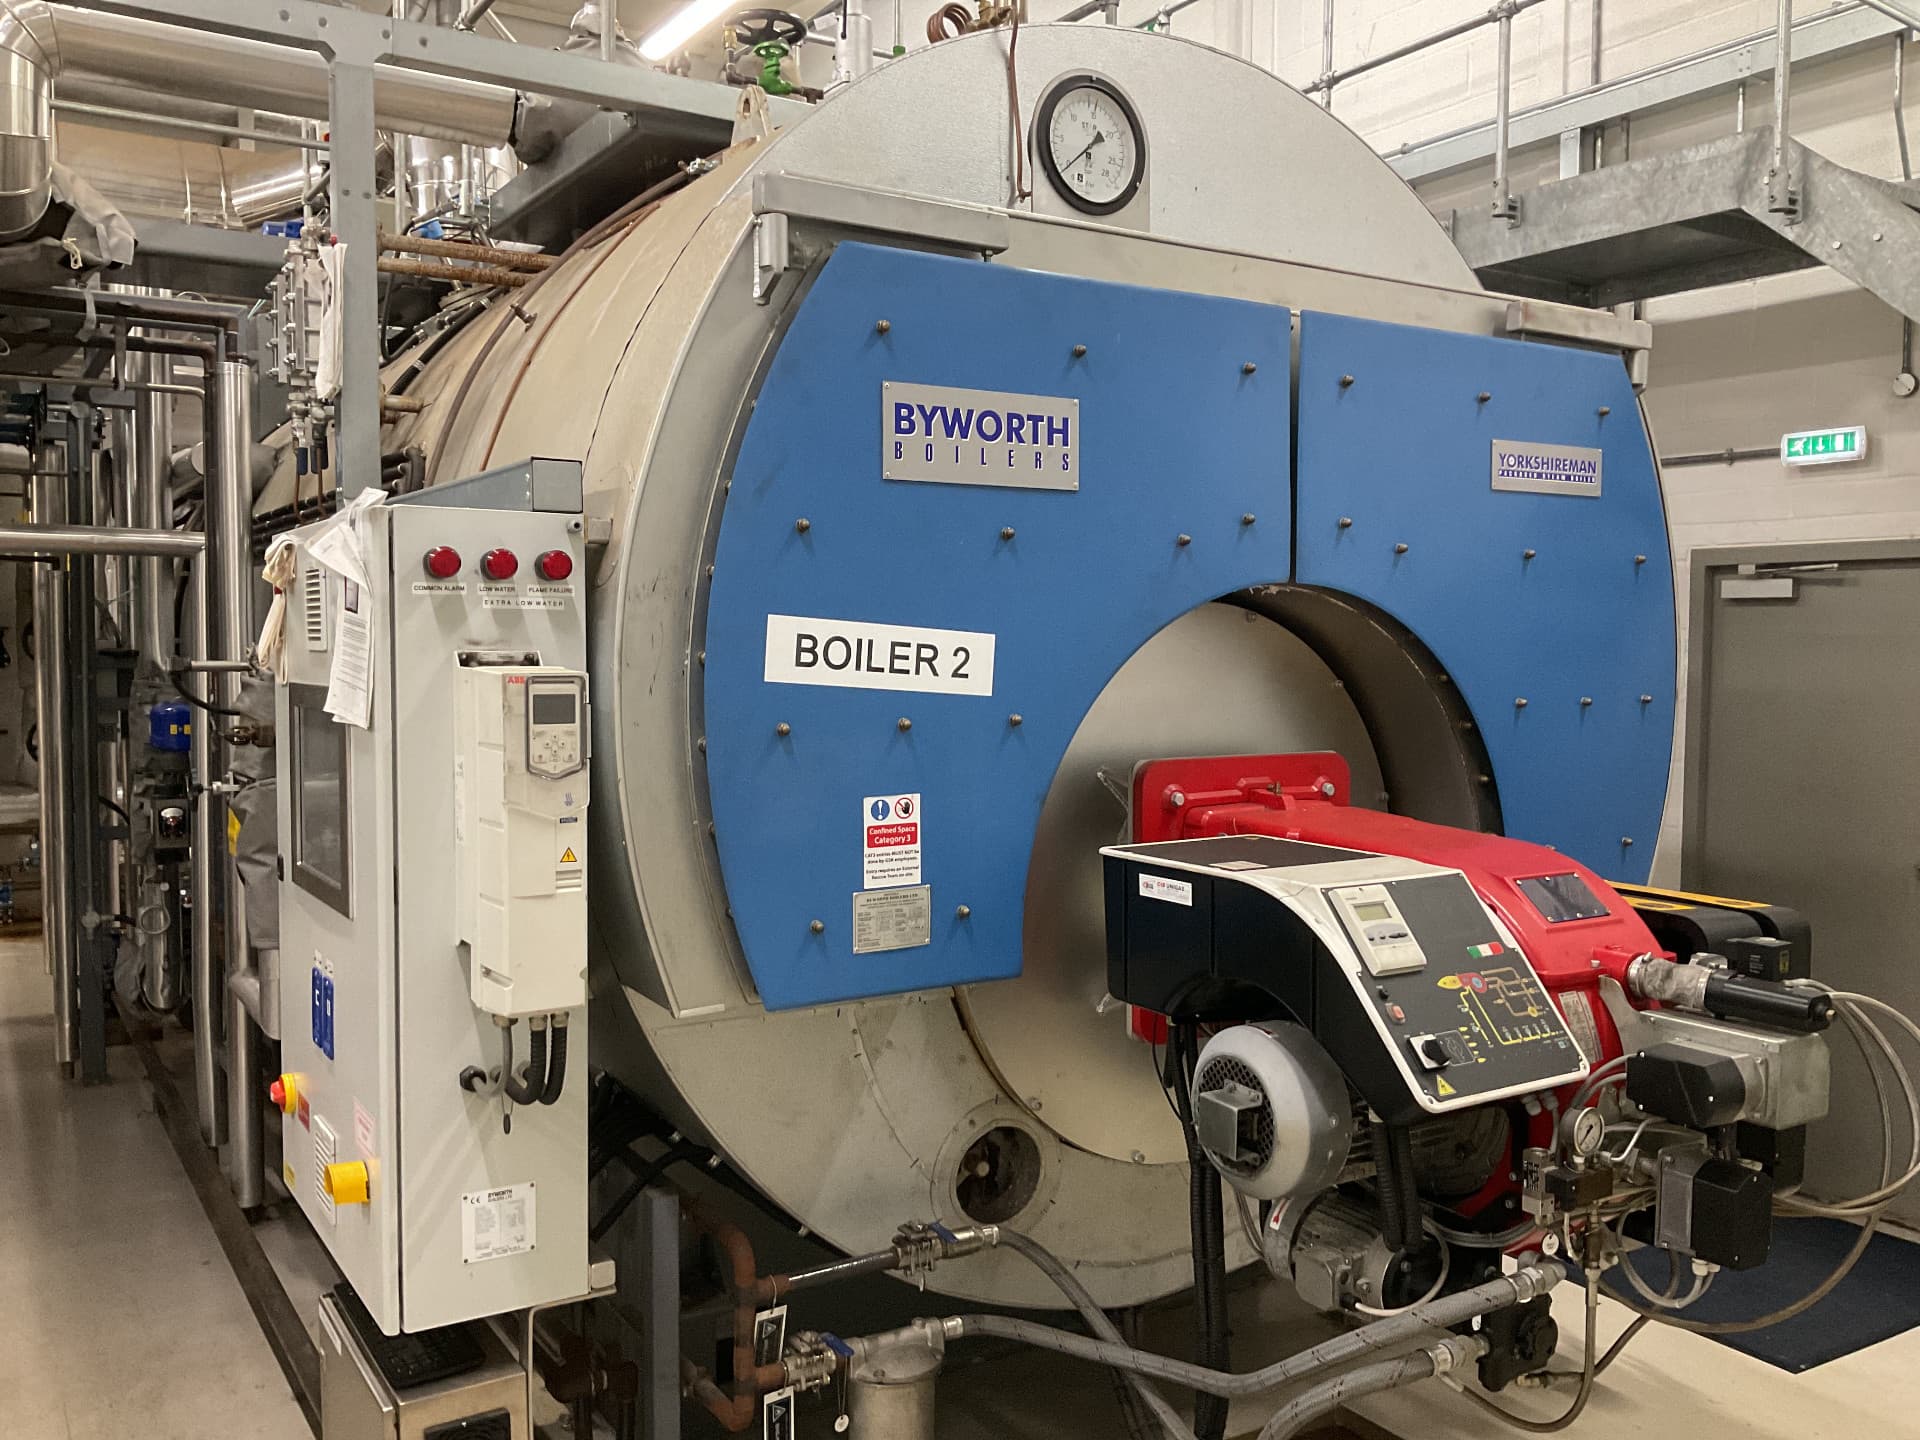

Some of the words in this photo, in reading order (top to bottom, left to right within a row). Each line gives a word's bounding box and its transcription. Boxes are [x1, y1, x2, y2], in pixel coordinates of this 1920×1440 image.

[1070, 113, 1077, 122] 10
[1105, 130, 1114, 139] 20
[1101, 168, 1110, 177] 28
[894, 402, 1070, 448] BYWORTH
[894, 441, 1070, 471] BOILERS
[1499, 453, 1597, 474] YORKSHIREMAN
[794, 632, 940, 677] BOILER
[951, 646, 971, 679] 2
[507, 675, 526, 684] ABB
[869, 826, 897, 835] Confined
[897, 826, 915, 834] Space
[874, 835, 905, 845] Category
